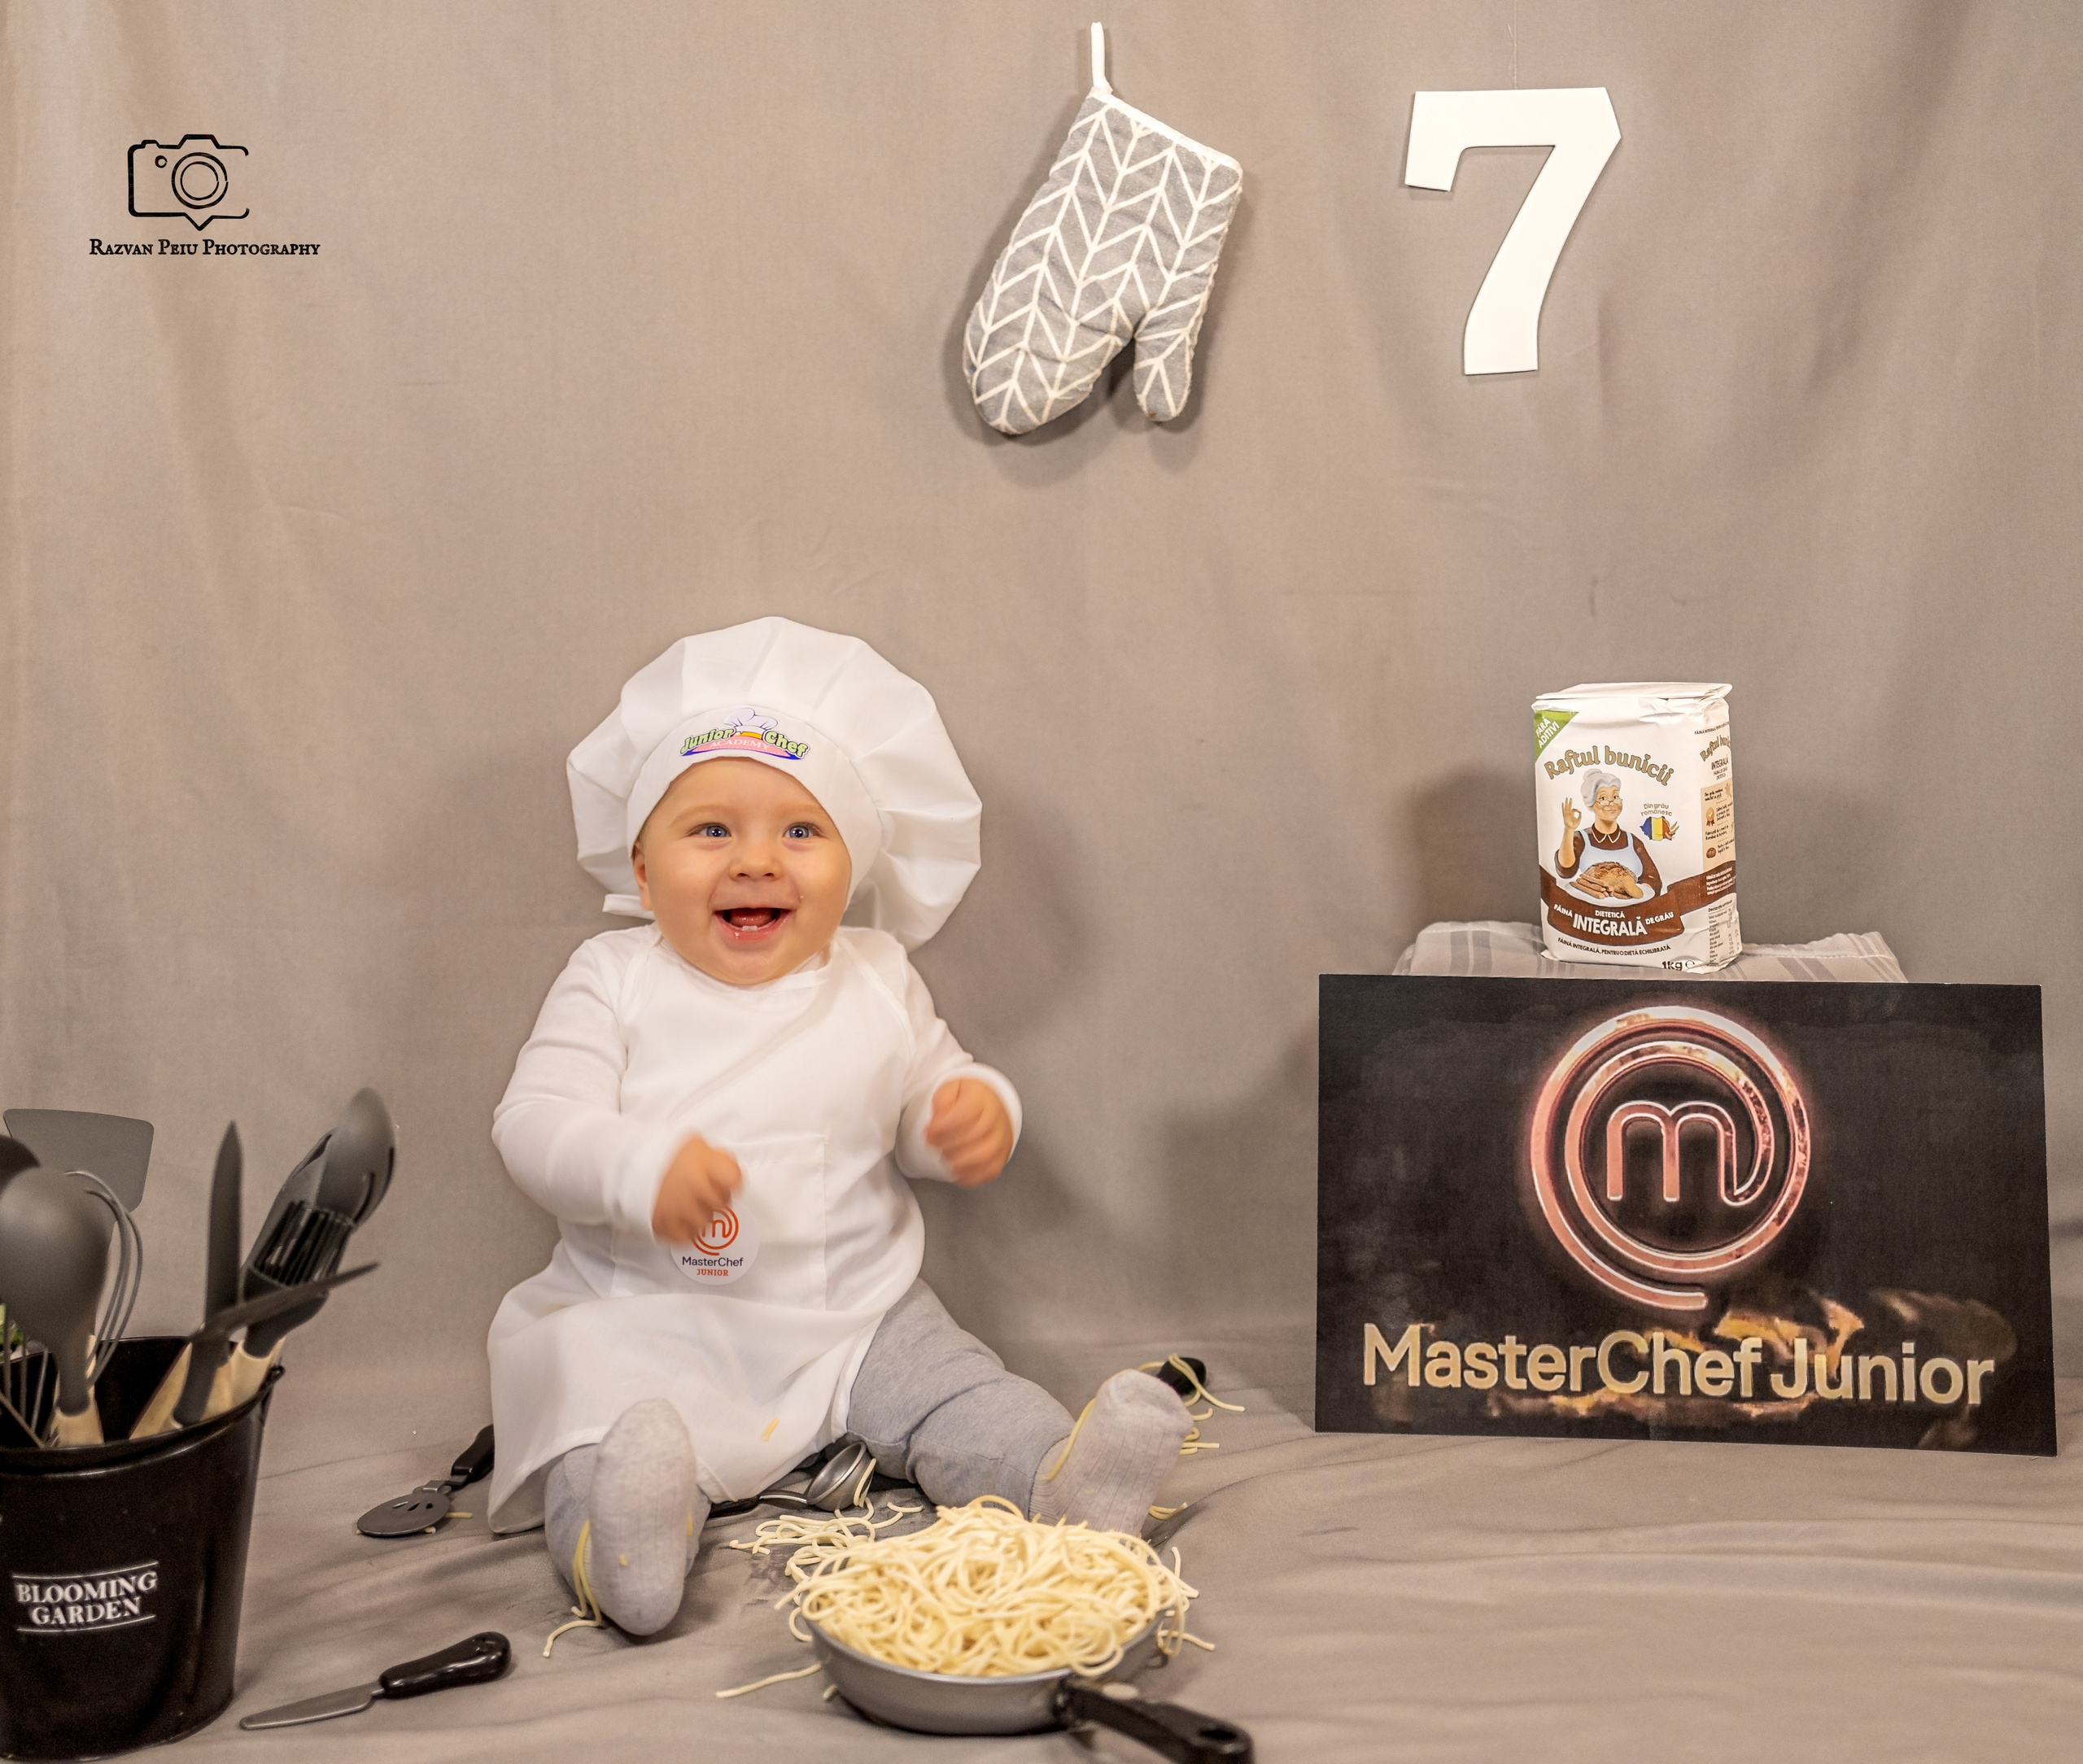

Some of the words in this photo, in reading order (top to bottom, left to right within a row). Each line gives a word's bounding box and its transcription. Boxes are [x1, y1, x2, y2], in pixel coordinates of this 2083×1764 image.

[1404, 87, 1622, 375] 7
[680, 727, 736, 755] Junior
[765, 731, 809, 758] Chef
[710, 738, 770, 750] ACADEMY
[1538, 721, 1560, 749] ADITIVI
[1544, 745, 1600, 779] Raftul
[1605, 745, 1675, 786] bunicii
[1572, 913, 1648, 937] INTEGRALĂ
[682, 1256, 744, 1267] MasterChef
[697, 1268, 729, 1277] JUNIOR
[1363, 1322, 1762, 1397] MasterChef
[1771, 1336, 1995, 1405] Junior
[15, 1570, 158, 1603] BLOOMING
[31, 1596, 141, 1625] GARDEN
